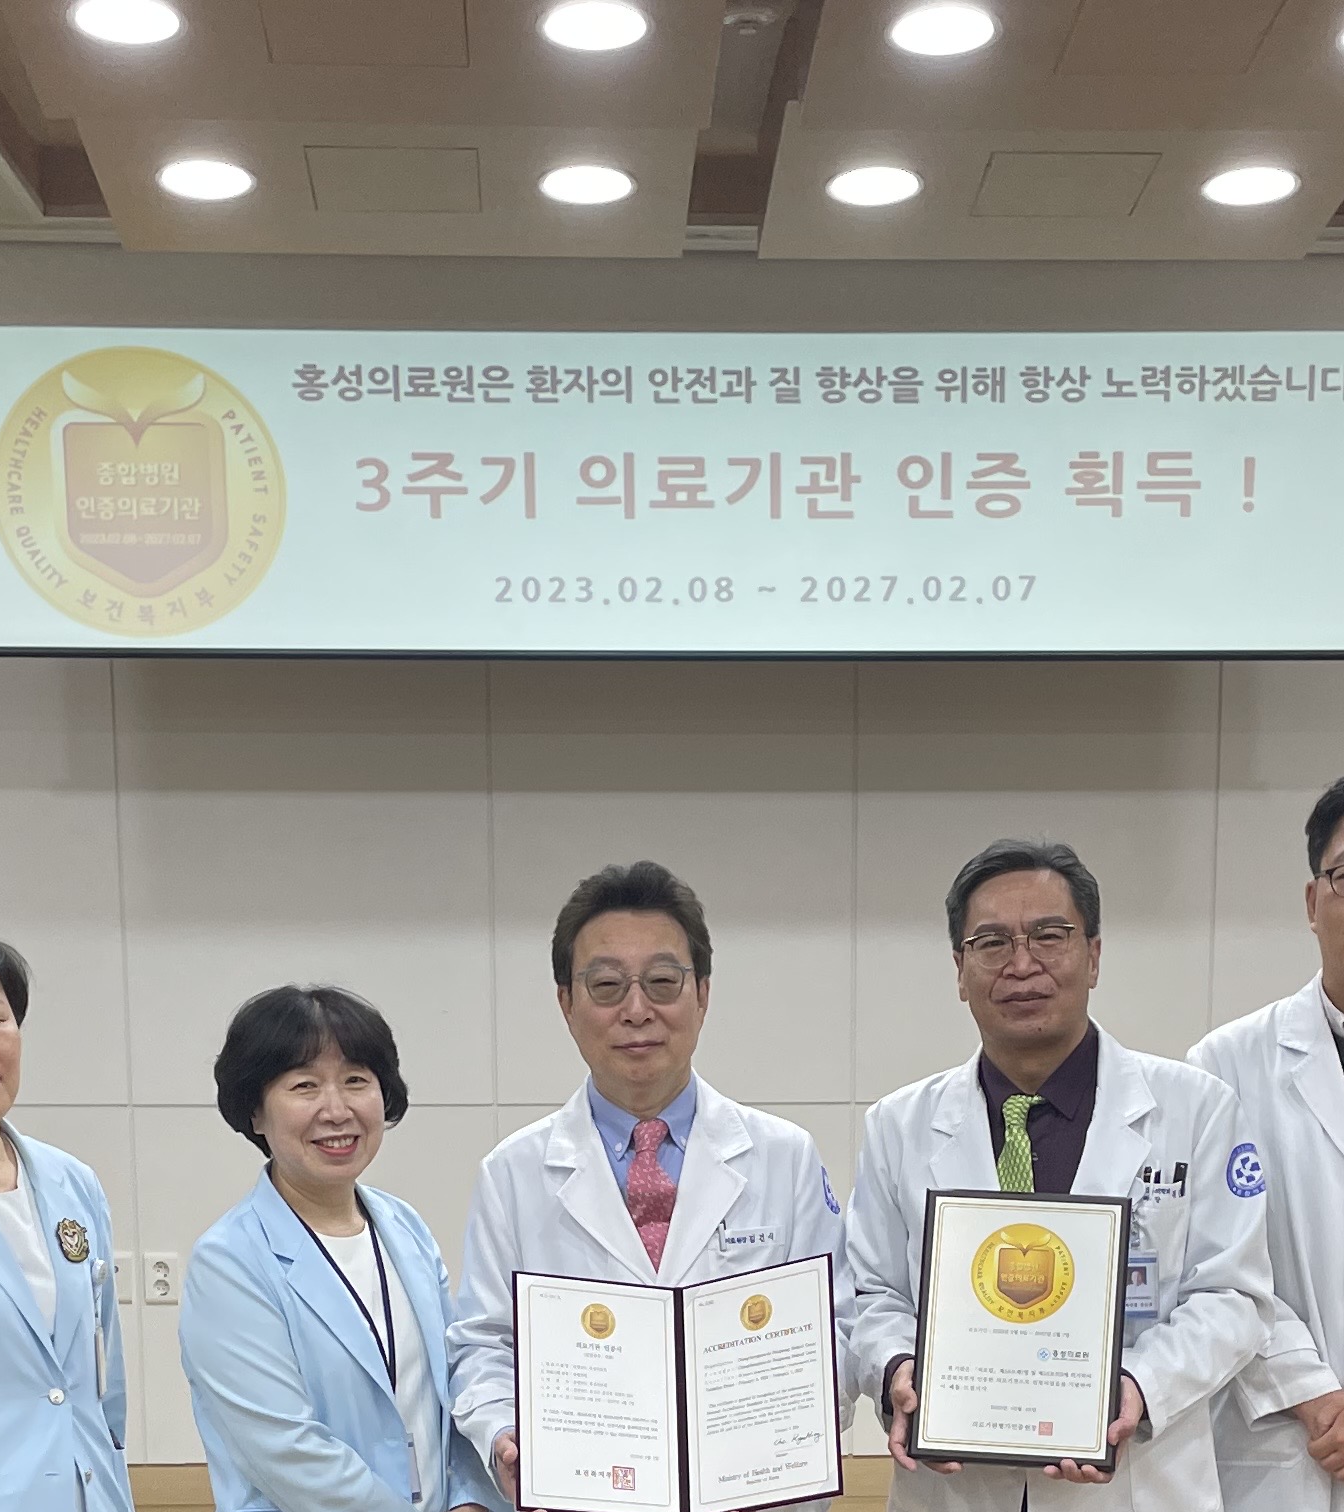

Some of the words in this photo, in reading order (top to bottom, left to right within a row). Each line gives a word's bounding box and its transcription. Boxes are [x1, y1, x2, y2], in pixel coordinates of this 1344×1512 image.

[291, 363, 516, 403] 홍성의료원은
[525, 364, 635, 404] 환자의
[648, 366, 758, 404] 안전과
[768, 366, 802, 404] 질
[814, 365, 925, 403] 향상을
[934, 366, 1007, 404] 위해
[1019, 365, 1092, 403] 항상
[6, 405, 49, 516] HEALTHCARE
[96, 461, 181, 487] 종합병원
[221, 408, 269, 496] PATIENT
[75, 495, 203, 521] 인증의료기관
[355, 451, 537, 520] 3주기
[576, 451, 862, 521] 의료기관
[897, 451, 1032, 520] 인증
[1065, 450, 1202, 519] 획득
[1242, 456, 1256, 514] !
[15, 525, 69, 590] QUALITY
[223, 513, 267, 587] SAFETY
[494, 576, 736, 606] 2023.02.08
[799, 575, 1038, 605] 2027.02.07
